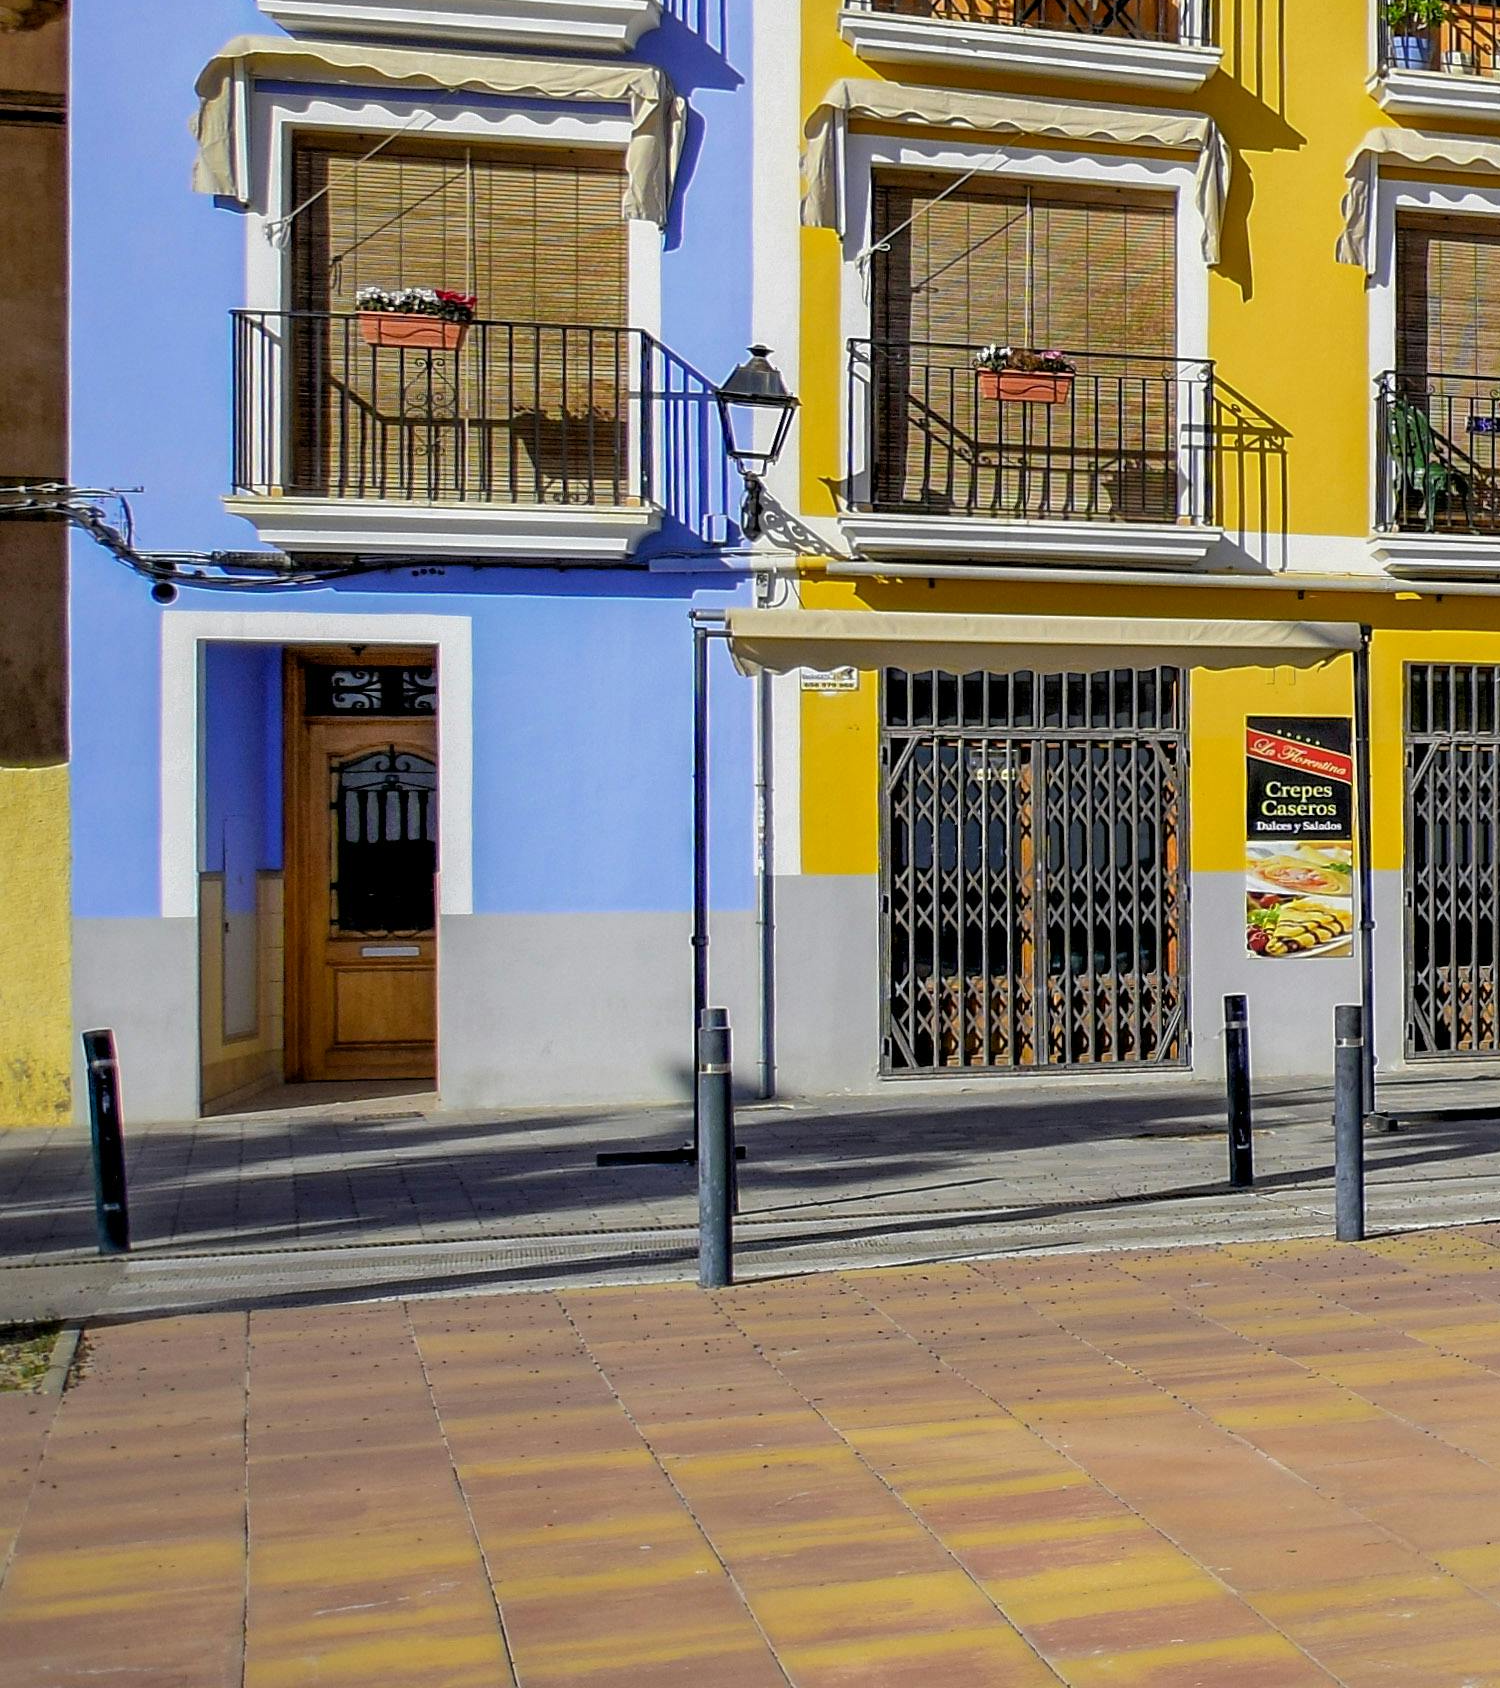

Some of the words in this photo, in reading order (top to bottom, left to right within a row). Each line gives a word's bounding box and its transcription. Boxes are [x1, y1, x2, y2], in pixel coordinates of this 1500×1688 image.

[1249, 738, 1276, 756] La
[1277, 745, 1347, 775] Florentina
[1265, 781, 1333, 802] Crepes
[1261, 800, 1337, 816] Caseros
[1256, 821, 1292, 831] Dulces
[1293, 823, 1301, 833] y
[1302, 821, 1342, 831] Salados
